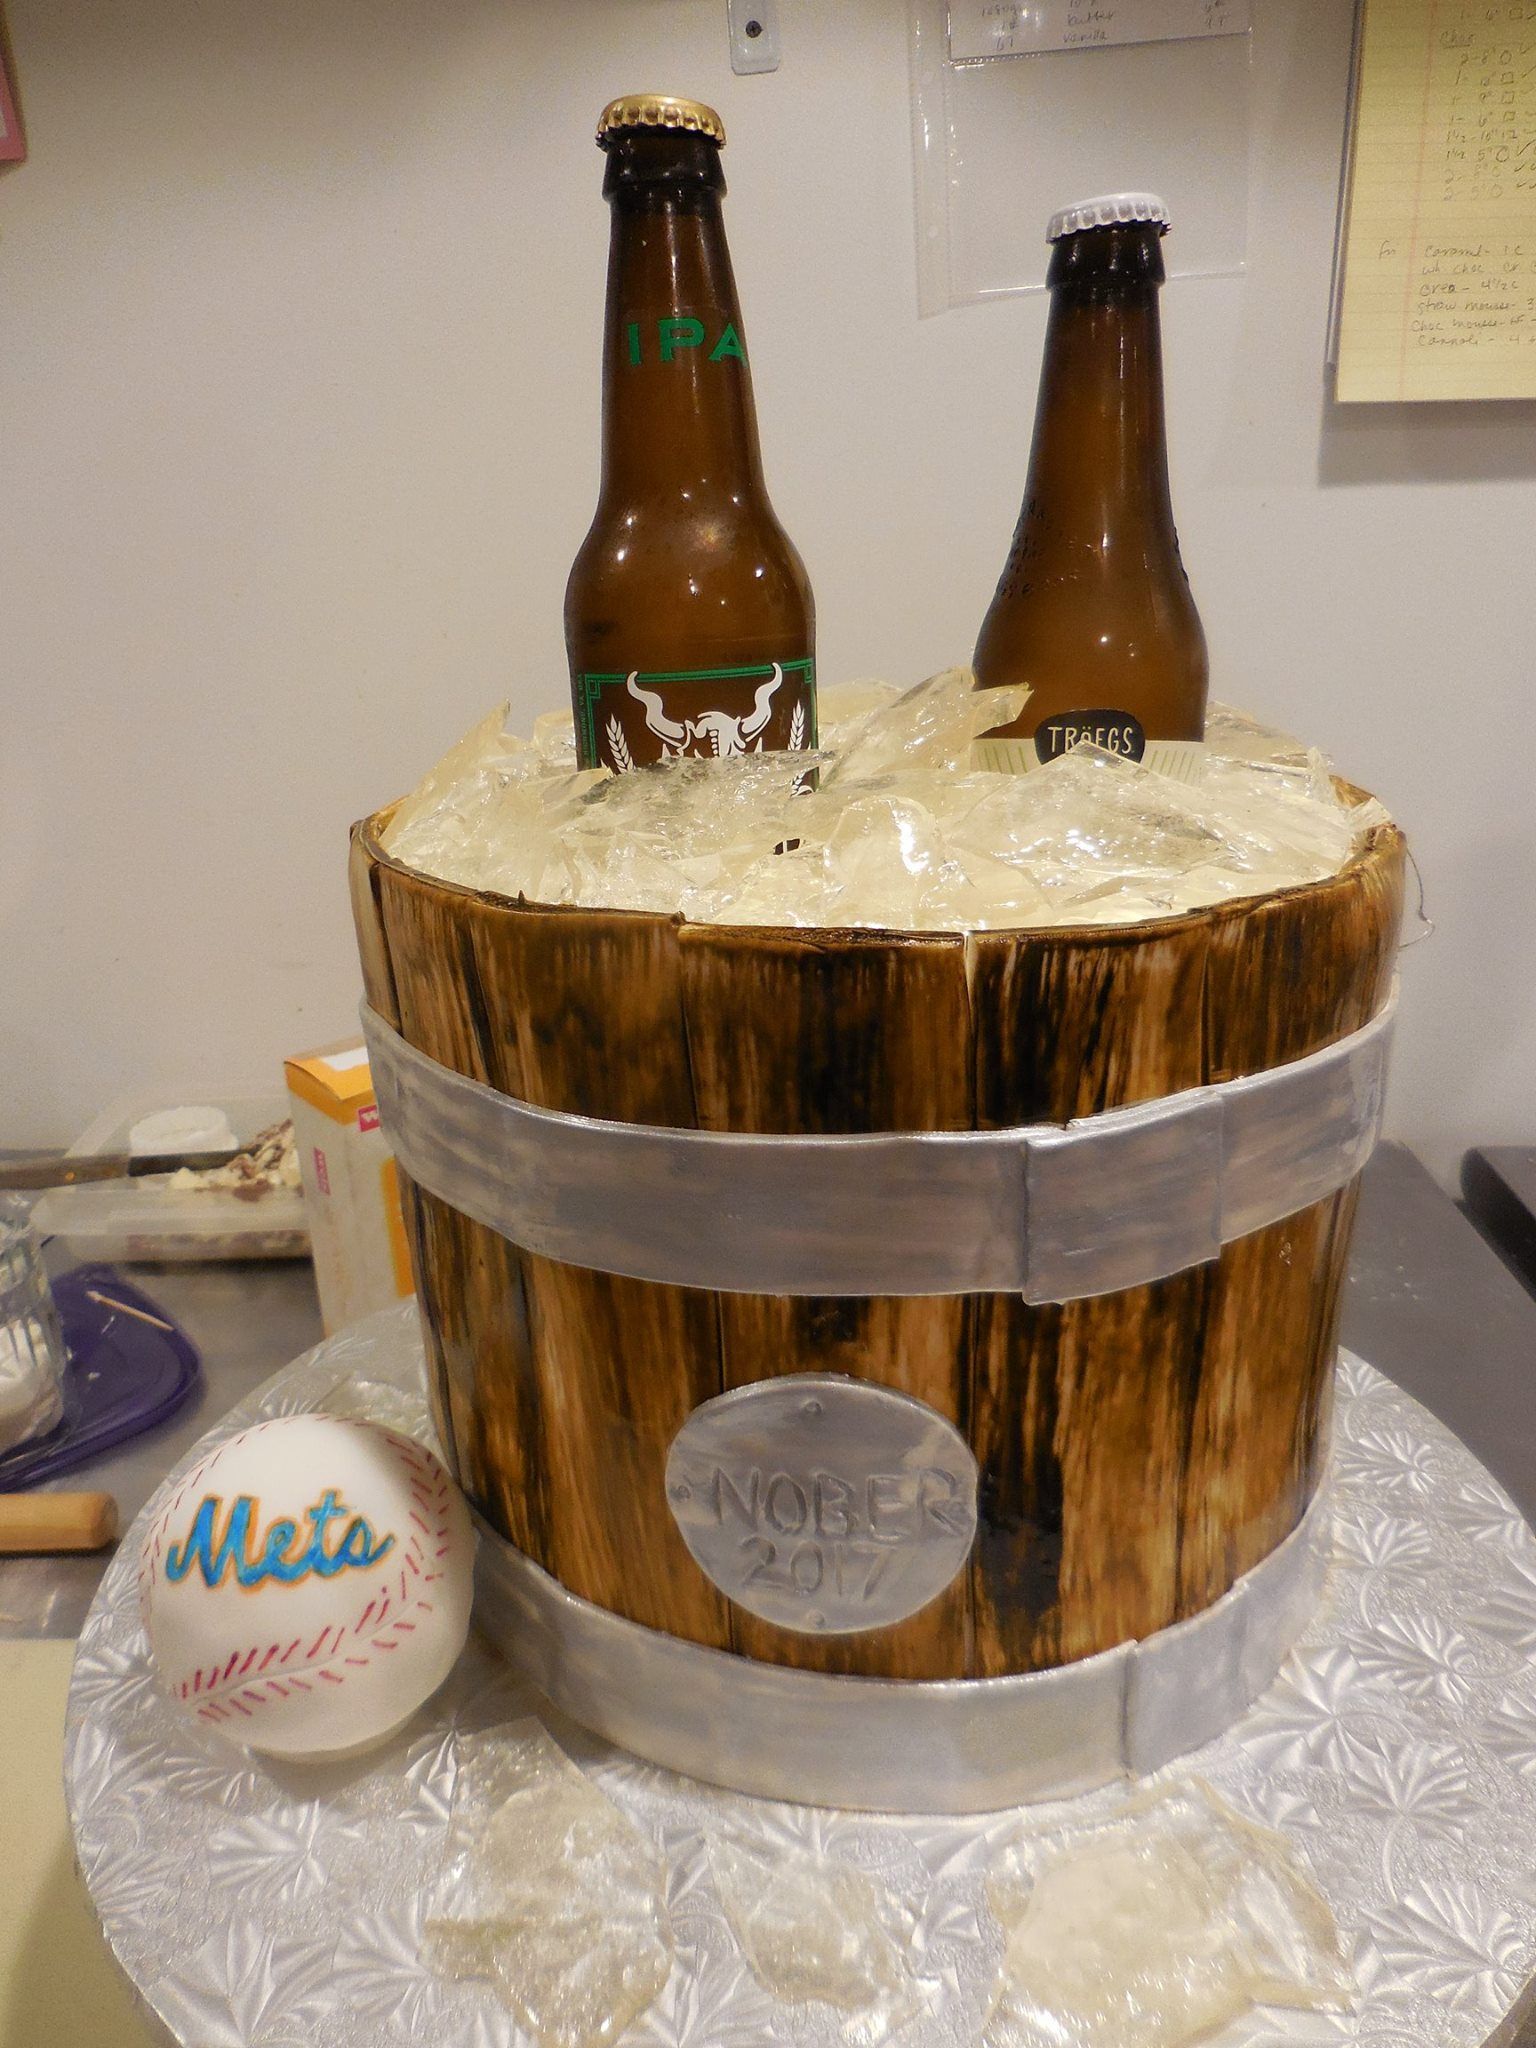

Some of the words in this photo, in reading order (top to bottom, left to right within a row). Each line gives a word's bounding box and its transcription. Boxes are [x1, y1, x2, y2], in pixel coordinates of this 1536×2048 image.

[627, 317, 749, 367] IPA
[709, 1466, 968, 1541] NOBER
[163, 1487, 396, 1592] Mets
[738, 1536, 900, 1601] 2017
